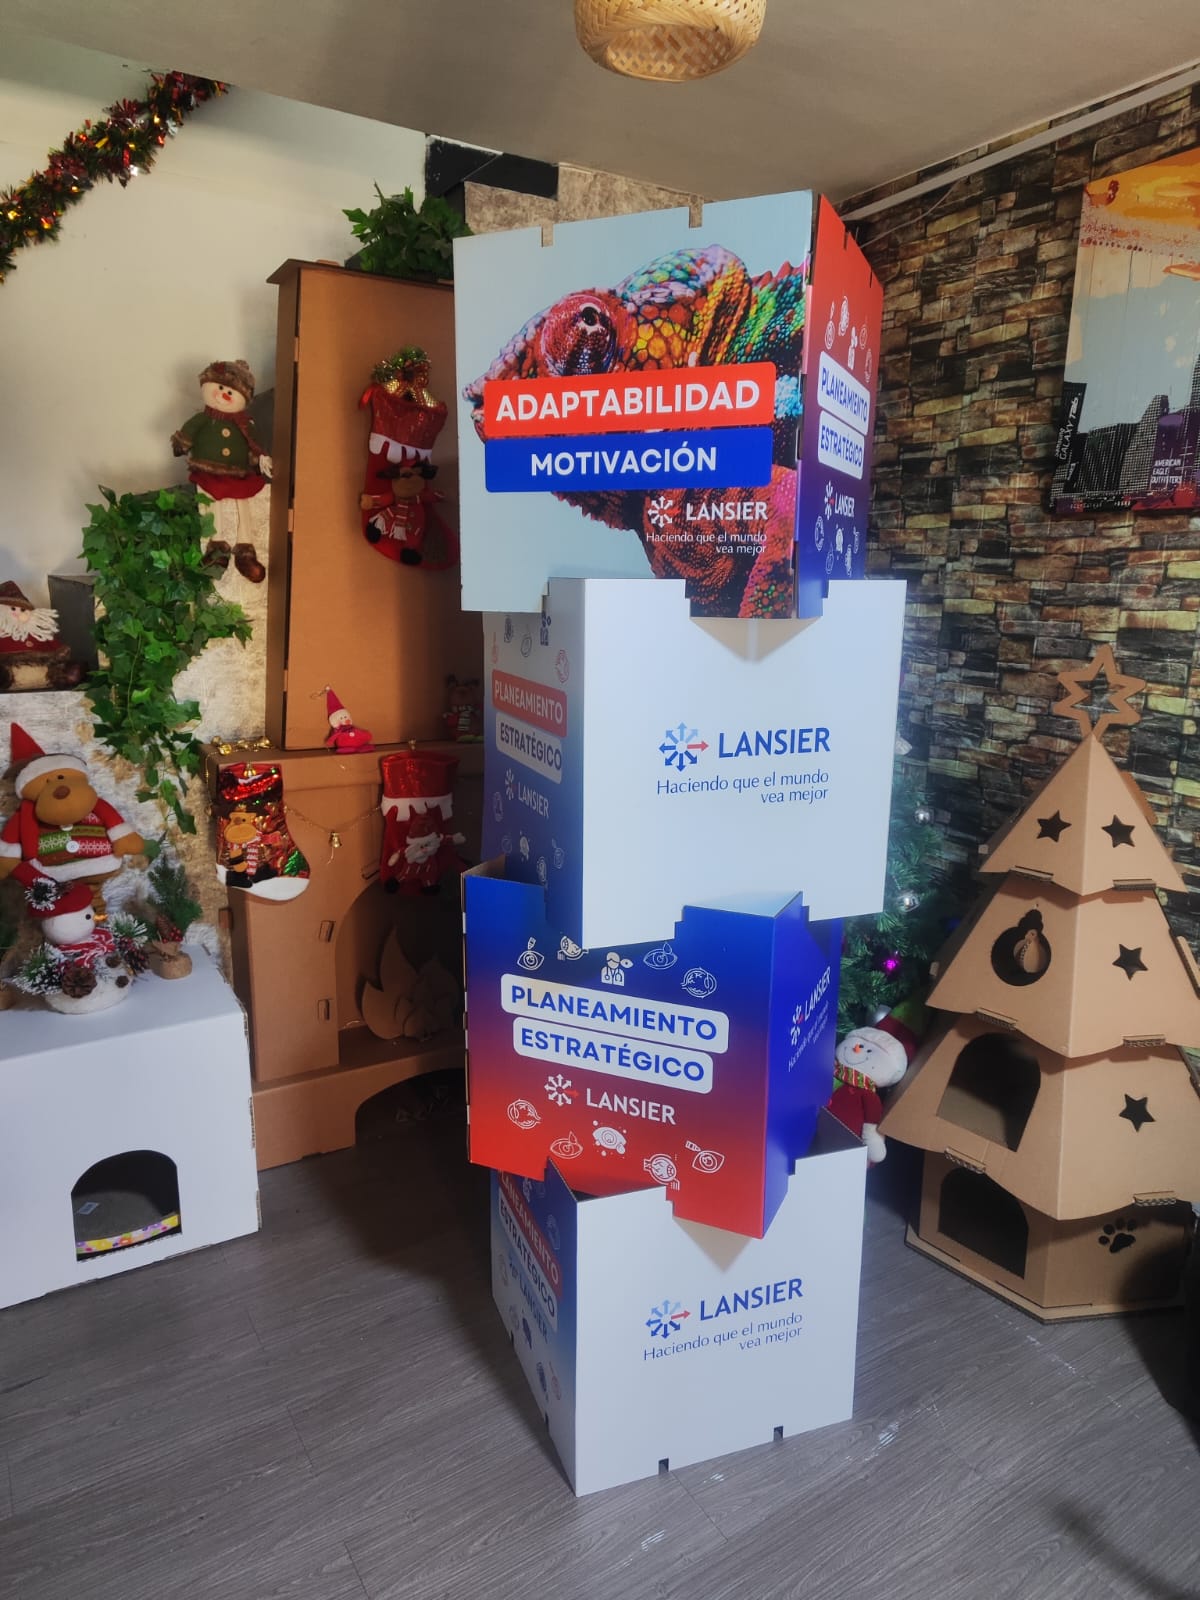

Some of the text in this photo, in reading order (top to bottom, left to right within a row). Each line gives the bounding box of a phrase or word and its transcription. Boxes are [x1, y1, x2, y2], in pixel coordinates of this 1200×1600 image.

[495, 379, 760, 422] ADAPTABILIDAD
[821, 365, 868, 422] PLANEAMIENTO
[531, 441, 717, 477] MOTIVACIÓN
[820, 424, 864, 475] ESTRATÉGICO
[1058, 420, 1074, 460] GALAXY
[1151, 475, 1183, 484] OUTFITTERS
[1152, 467, 1170, 475] EAGLE
[1154, 458, 1182, 467] AMERICAN
[686, 501, 768, 521] LANSIER
[646, 531, 767, 545] Haciendo que el mundo
[715, 544, 767, 556] vea mejor
[494, 679, 564, 724] PLANEAMIENTO
[500, 721, 562, 771] ESTRATÉGICO
[719, 727, 831, 758] LANSIER
[518, 783, 549, 819] LANSIER
[657, 769, 829, 795] Haciendo que el mundo
[761, 786, 829, 805] vea mejor
[511, 985, 717, 1041] PLANEAMIENTO
[521, 1028, 705, 1082] ESTRATÉGICO
[586, 1087, 676, 1125] LANSIER
[500, 1169, 559, 1285] LANEAMIENTO
[500, 1198, 555, 1318] ESTRATÉGICO
[518, 1272, 548, 1343] LANSIER
[700, 1278, 804, 1321] LANSIER
[643, 1312, 803, 1361] Haciendo que el mundo
[739, 1326, 803, 1350] vea mejor
